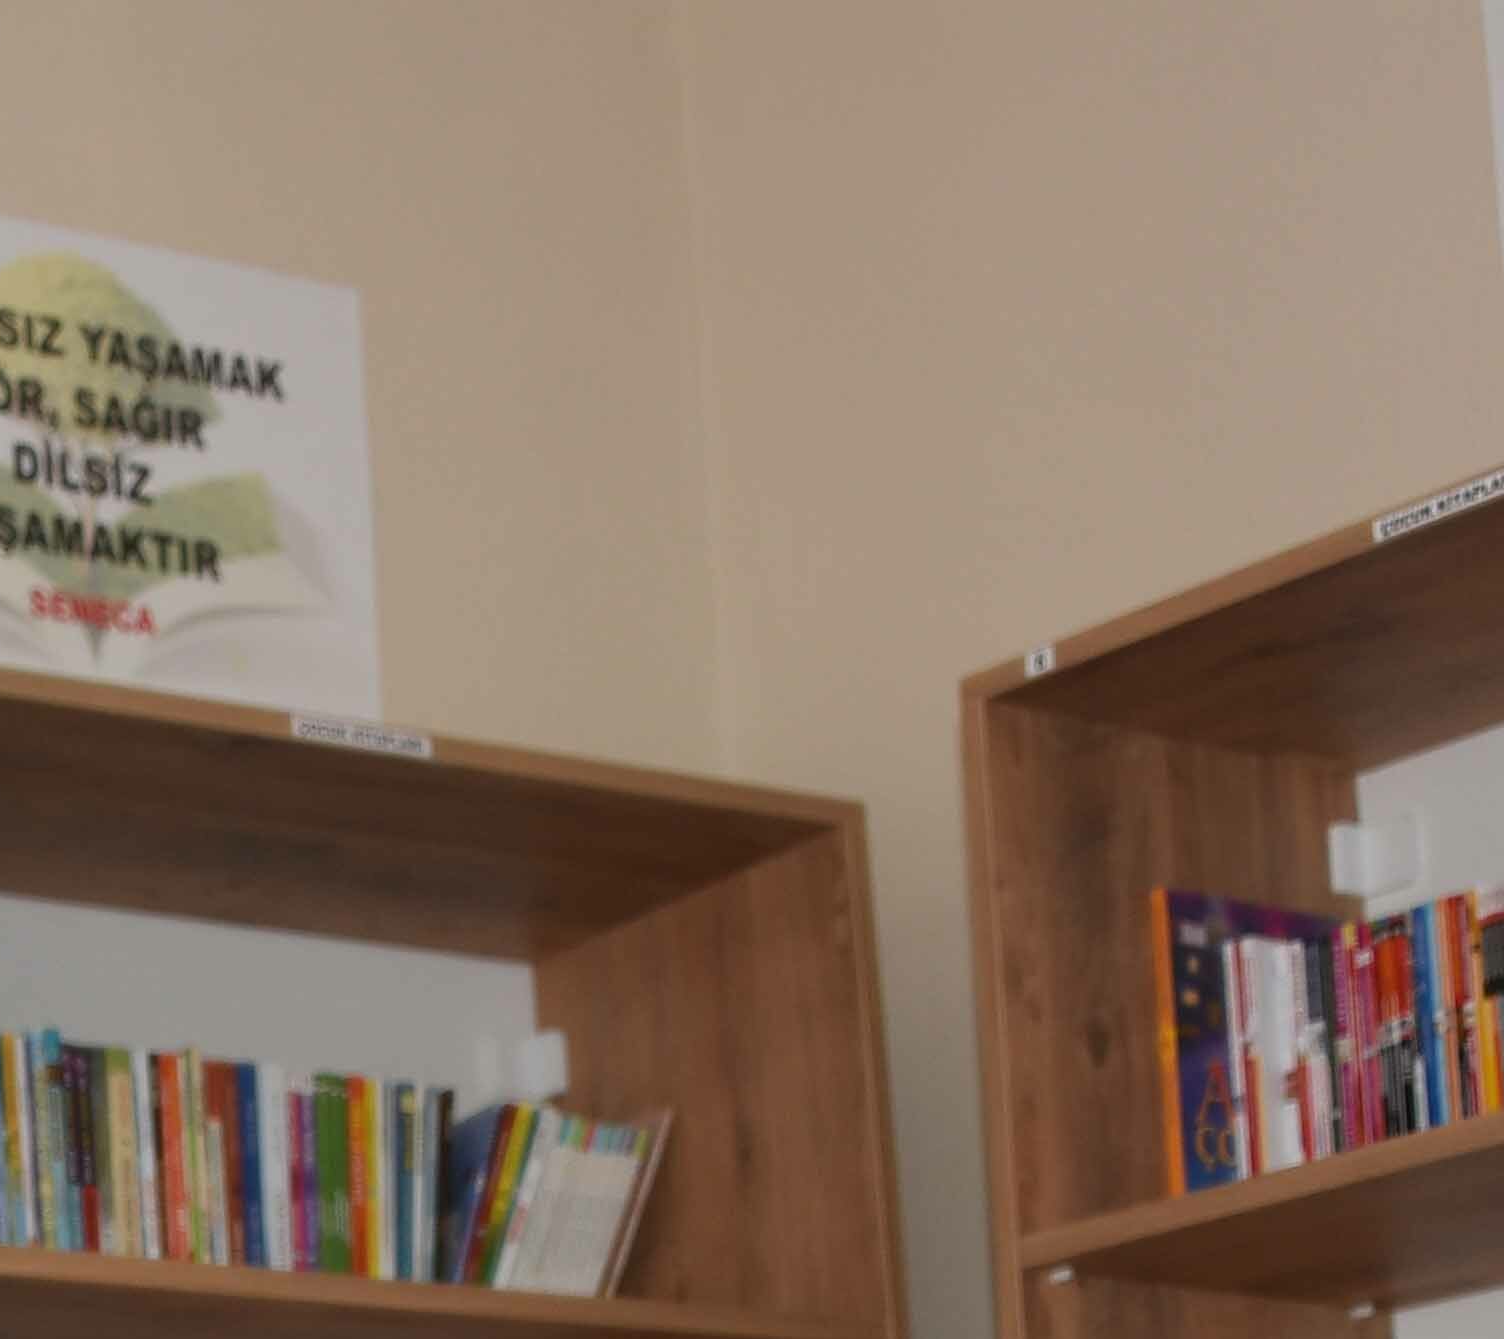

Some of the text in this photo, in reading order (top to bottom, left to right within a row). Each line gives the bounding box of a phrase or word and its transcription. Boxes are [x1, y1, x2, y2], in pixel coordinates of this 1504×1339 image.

[78, 328, 284, 400] YAŞAMAK
[72, 386, 208, 448] SAĞIR
[11, 439, 153, 503] DİLSİZ
[29, 589, 156, 636] SENECA
